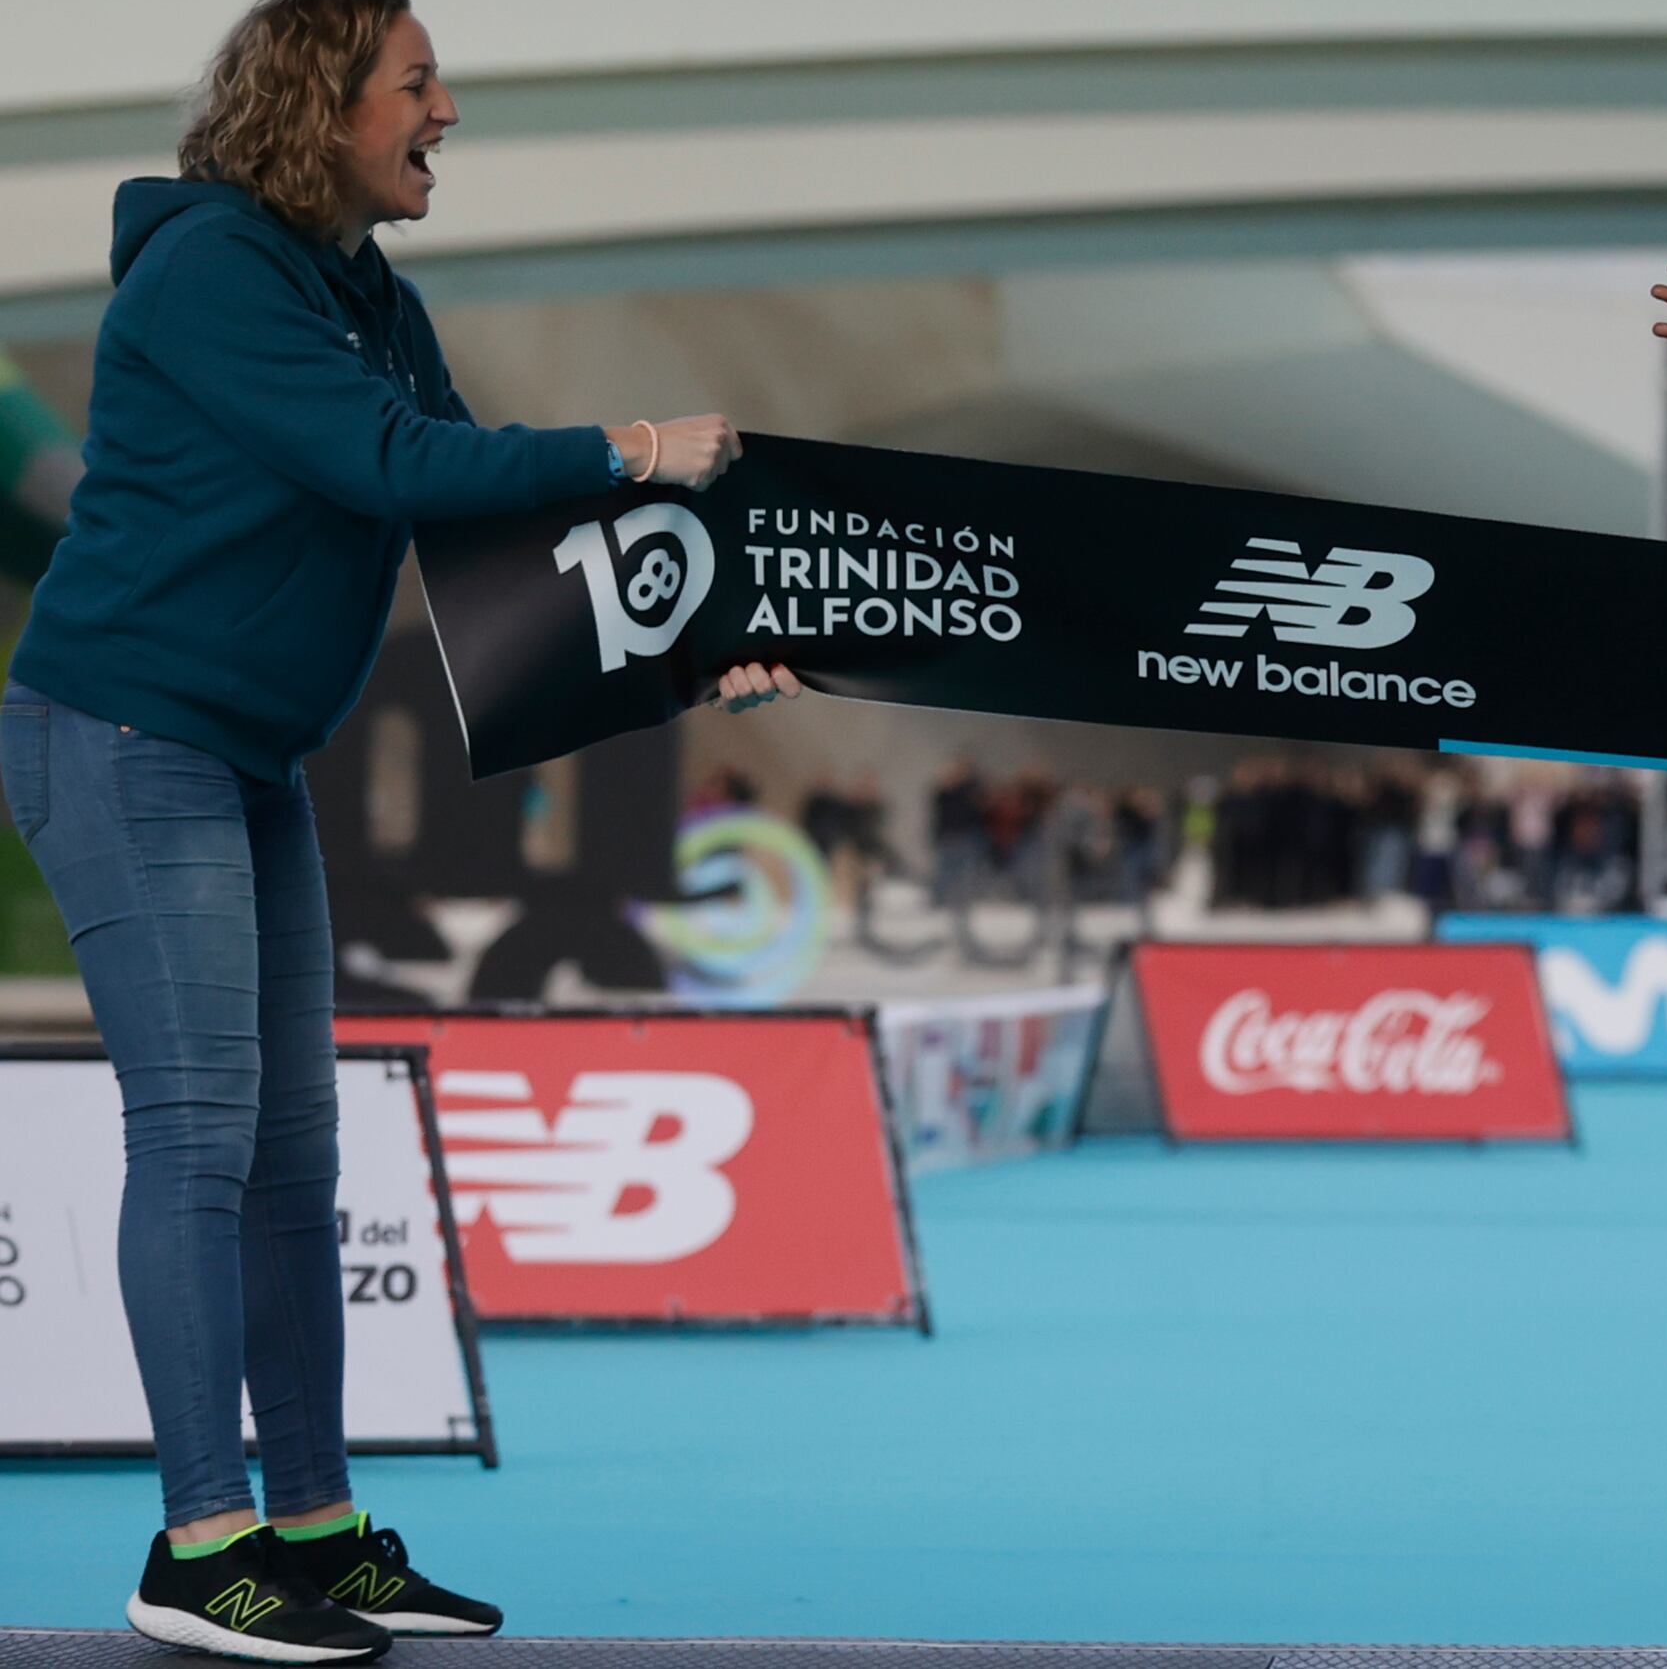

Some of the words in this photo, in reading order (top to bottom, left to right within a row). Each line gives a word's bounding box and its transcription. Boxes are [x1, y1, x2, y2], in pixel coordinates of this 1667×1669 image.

[747, 508, 1015, 559] FUNDACIÓN
[745, 545, 1020, 599] TRINIDAD
[746, 593, 1022, 642] ALFONSO
[1137, 649, 1244, 689] new
[1256, 653, 1477, 709] balance
[360, 1218, 408, 1246] del
